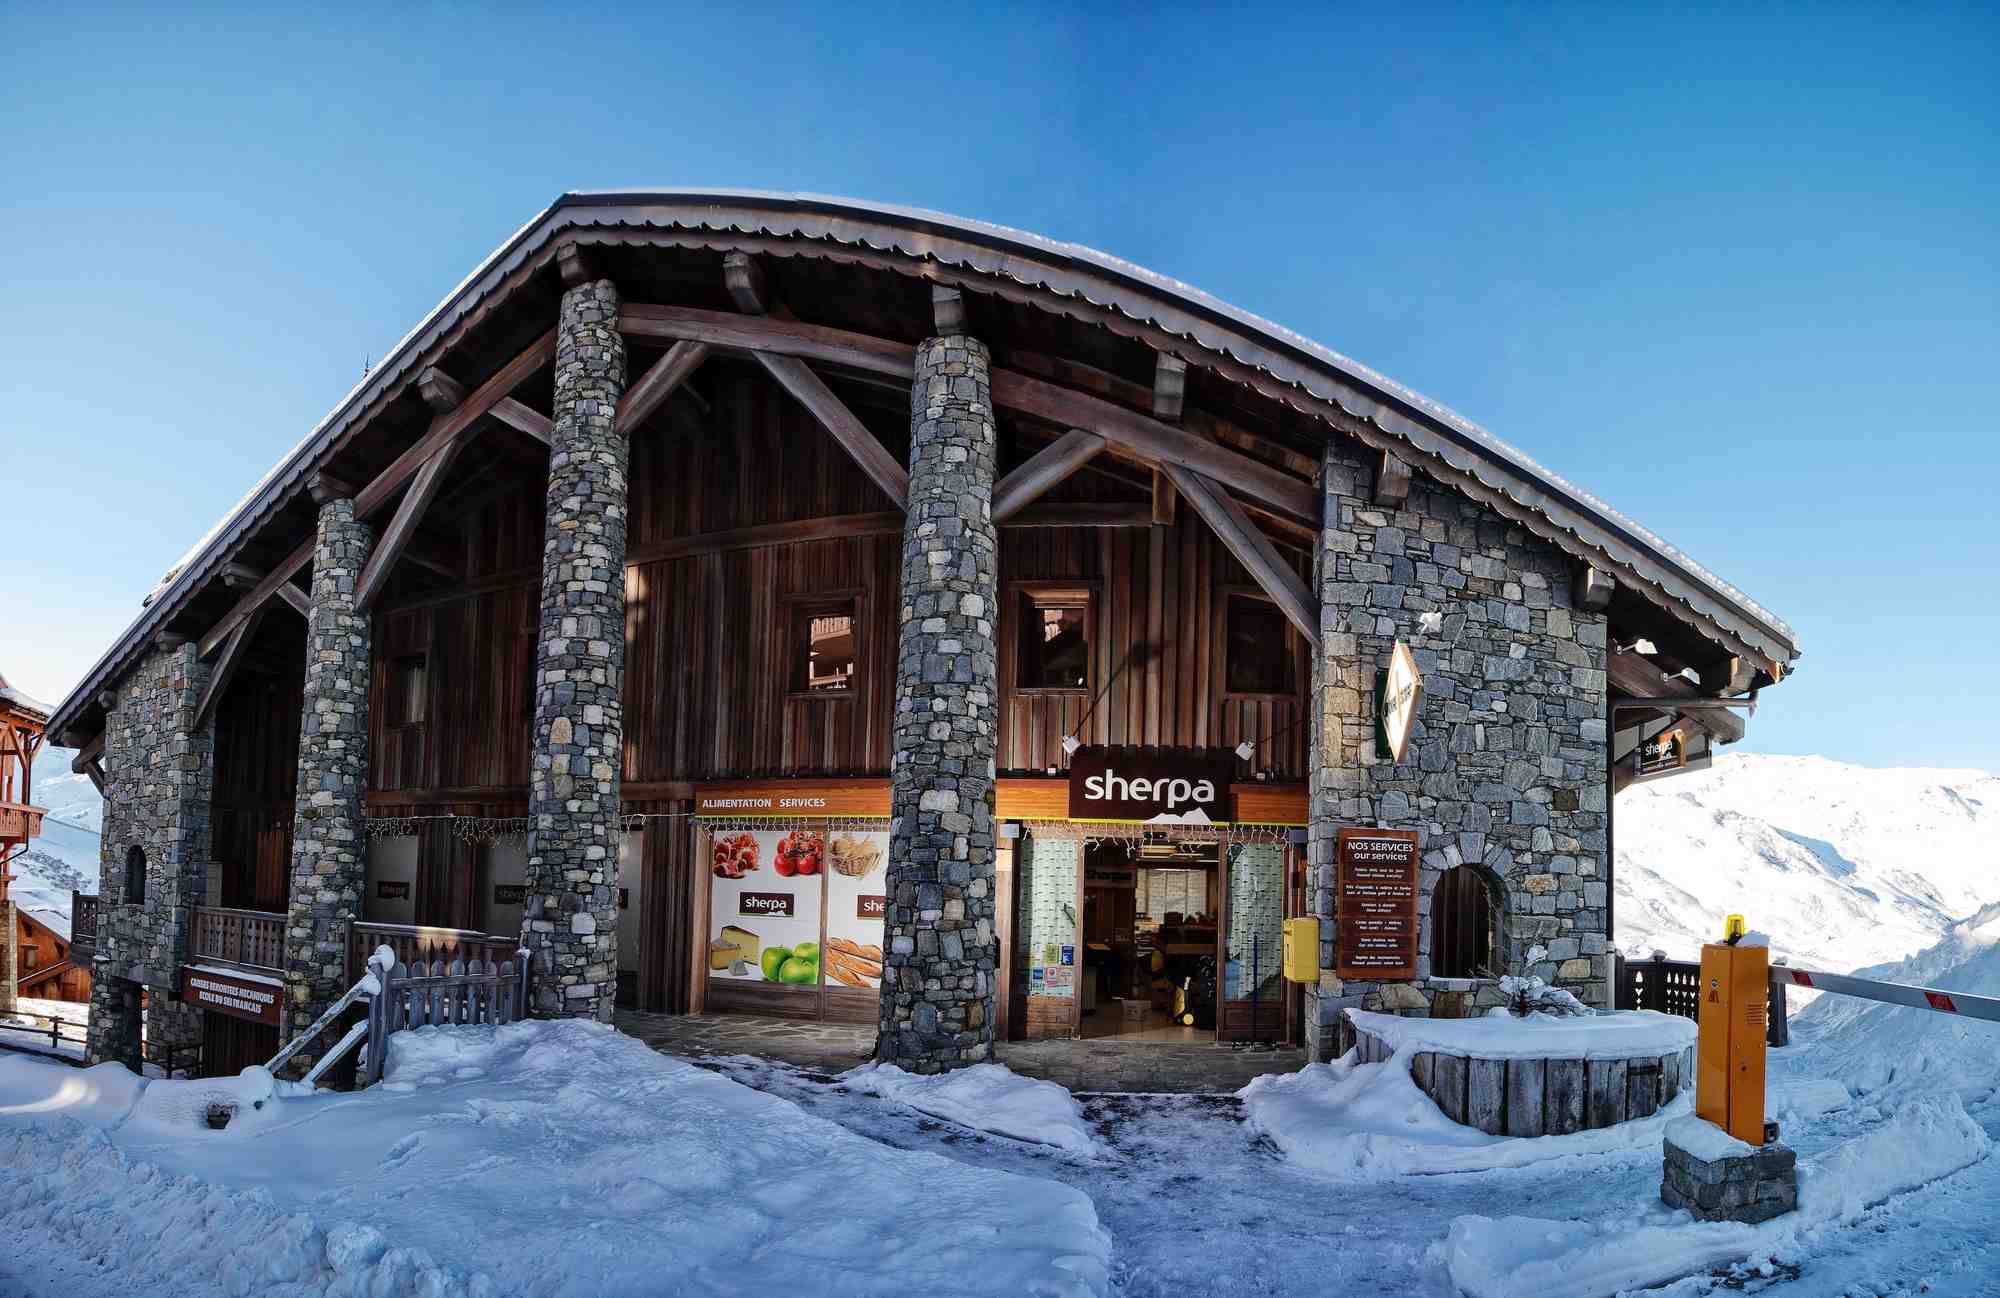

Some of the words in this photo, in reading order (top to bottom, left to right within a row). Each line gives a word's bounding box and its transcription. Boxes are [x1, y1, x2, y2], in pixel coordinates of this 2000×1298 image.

[1084, 769, 1215, 808] sherpa
[702, 799, 771, 808] ALIMENTATION
[779, 798, 826, 807] SERVICES
[1347, 842, 1368, 850] NOS
[1370, 843, 1414, 852] SERVICES
[1353, 852, 1370, 860] our
[1371, 852, 1408, 861] services
[745, 896, 787, 910] sherpa
